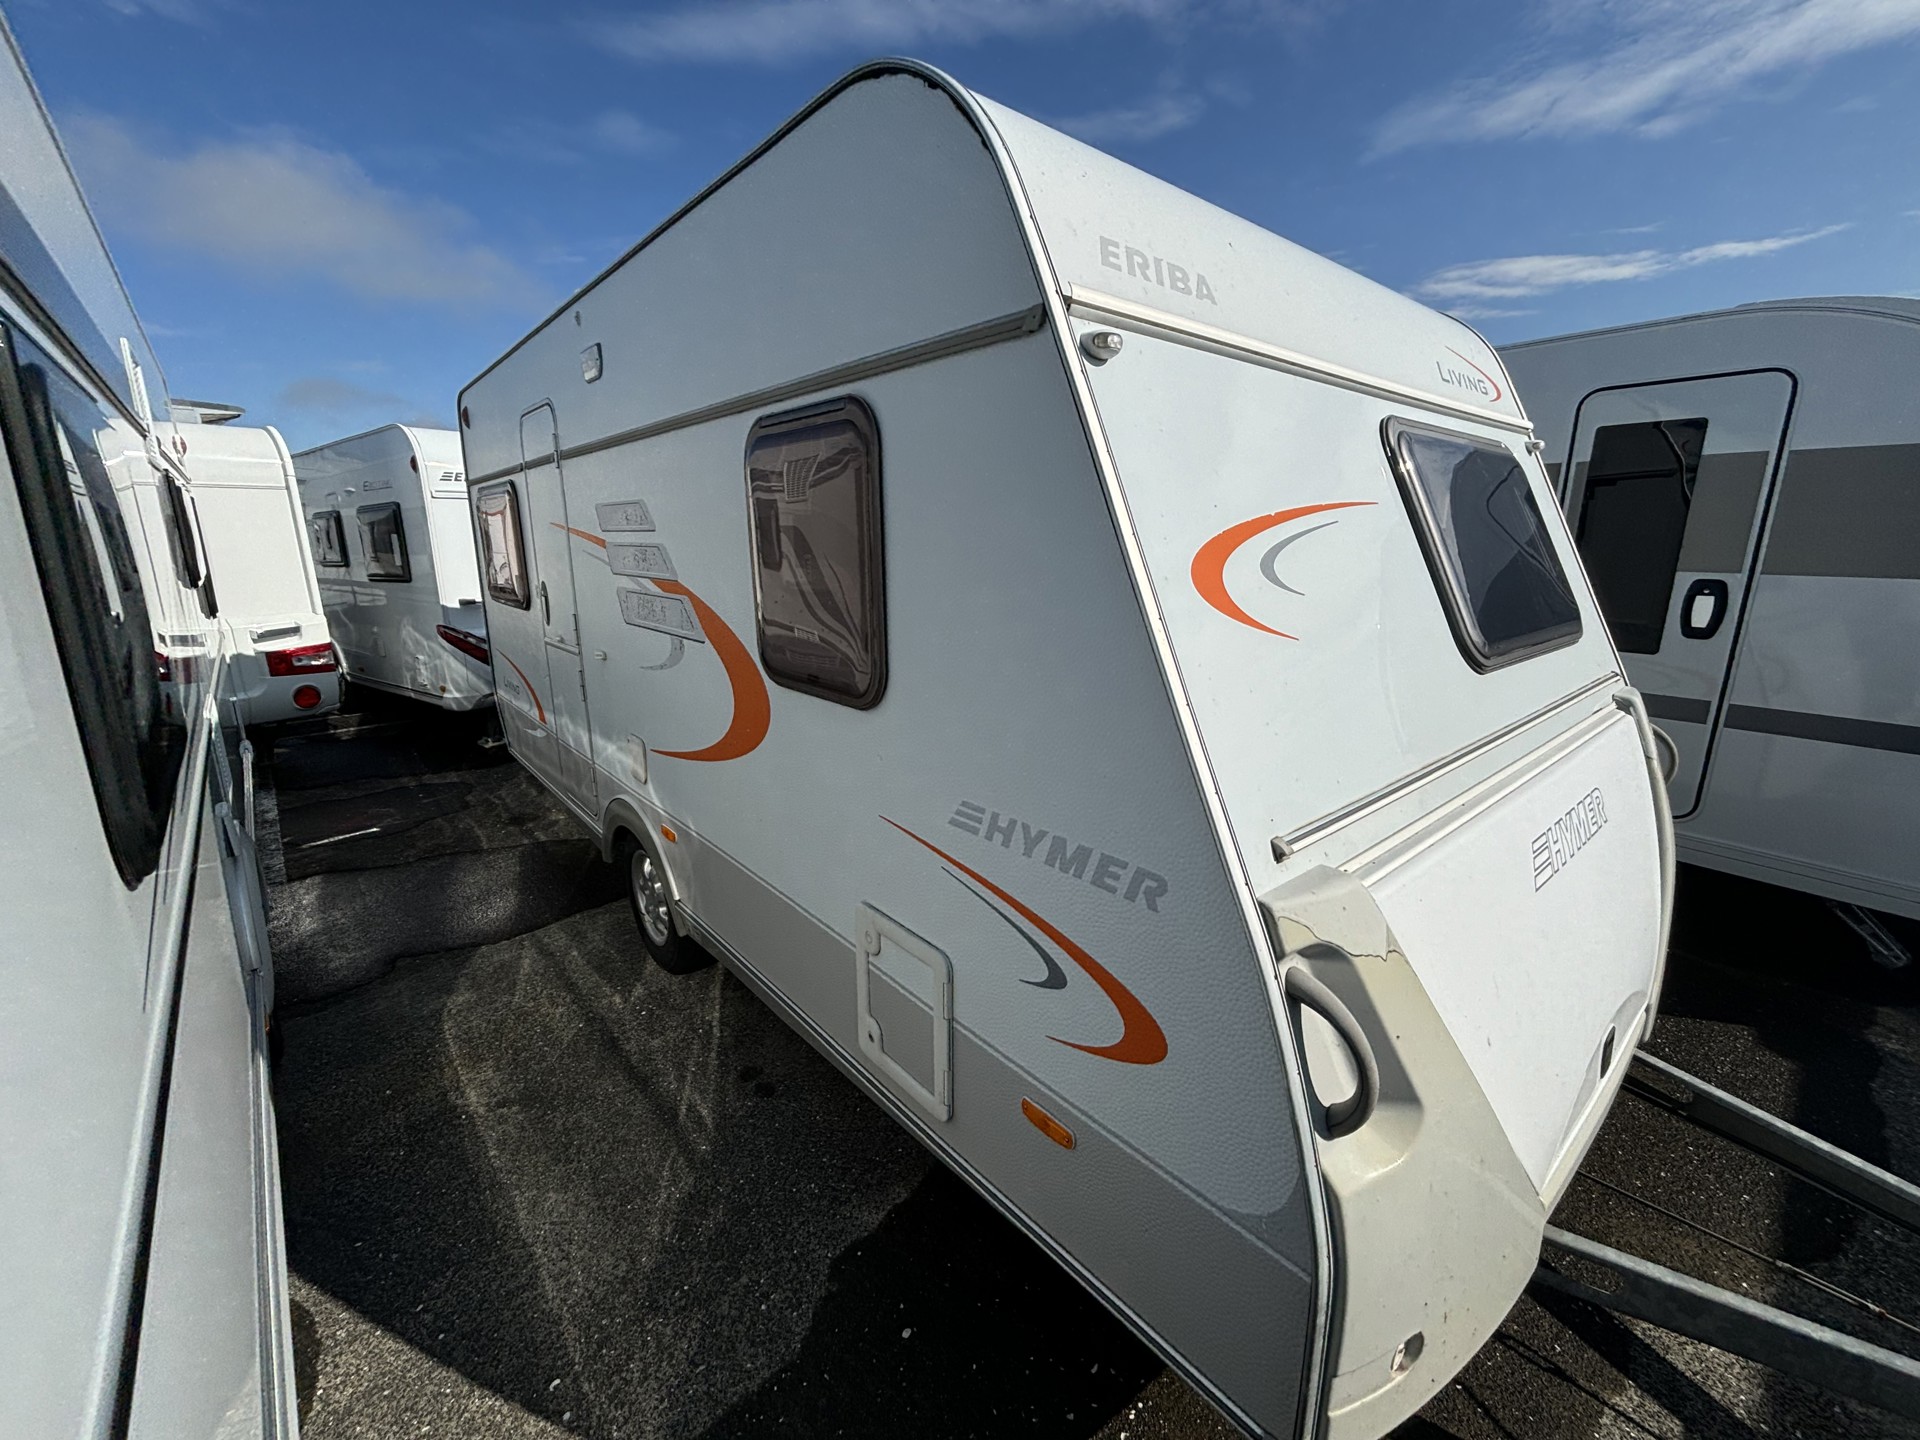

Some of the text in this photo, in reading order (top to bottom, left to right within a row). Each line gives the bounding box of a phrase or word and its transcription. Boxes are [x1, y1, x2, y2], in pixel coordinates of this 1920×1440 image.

[1099, 235, 1218, 305] ERIBA
[1436, 361, 1488, 395] LIVING
[984, 811, 1169, 913] HYMER
[1546, 787, 1608, 874] HYMER
